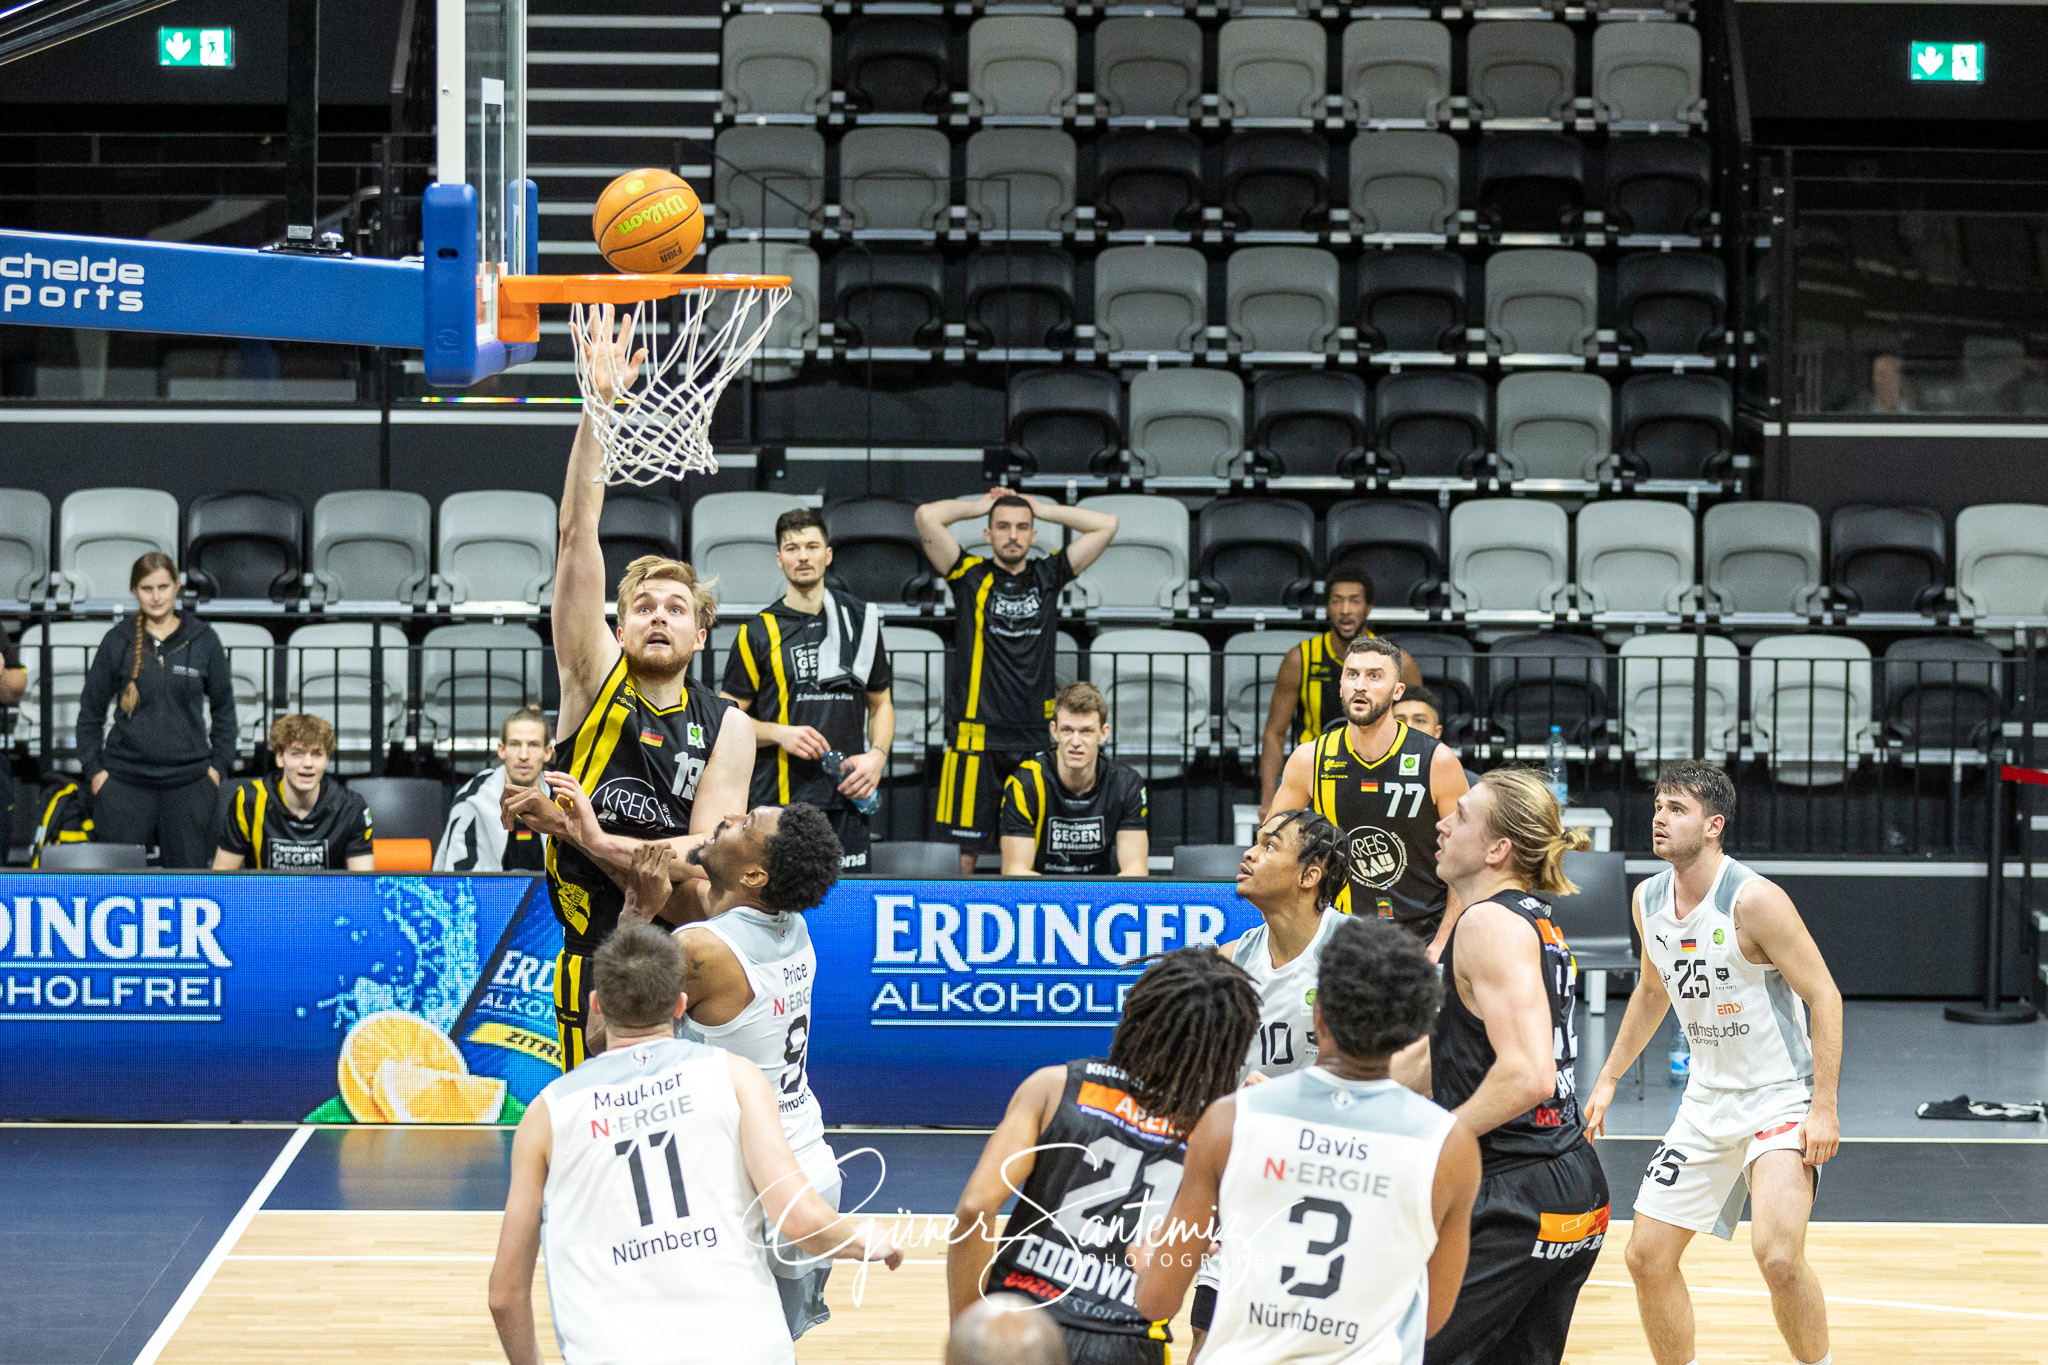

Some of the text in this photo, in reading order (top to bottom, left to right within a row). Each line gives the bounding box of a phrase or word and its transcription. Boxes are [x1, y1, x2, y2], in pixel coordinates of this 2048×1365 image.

[617, 194, 688, 235] Wilson
[659, 245, 683, 263] FIBA
[3, 284, 144, 312] ports
[671, 751, 706, 801] 19
[602, 786, 657, 822] KREIS
[1383, 781, 1426, 818] 77
[1052, 829, 1101, 842] GEGEN
[1351, 833, 1388, 859] KREIS
[1355, 853, 1396, 878] BAU
[0, 896, 232, 968] INGER
[873, 894, 1226, 972] ERDINGER
[0, 976, 221, 1007] HOLFREI
[783, 963, 808, 987] Price
[1673, 959, 1711, 999] 25
[871, 981, 1136, 1013] ALKOHOLF
[1716, 1002, 1742, 1016] EMS
[1259, 1022, 1295, 1066] 10
[1687, 1021, 1750, 1038] filmstudio
[780, 1014, 809, 1095] 9
[593, 1071, 684, 1110] Maukner
[1298, 1129, 1369, 1161] Davis
[614, 1129, 690, 1227] 11
[1053, 1135, 1184, 1248] 21
[612, 1225, 719, 1266] Nürnberg
[1280, 1196, 1352, 1300] 3
[1015, 1232, 1138, 1309] GOODWI
[1248, 1302, 1360, 1345] Nürnberg
